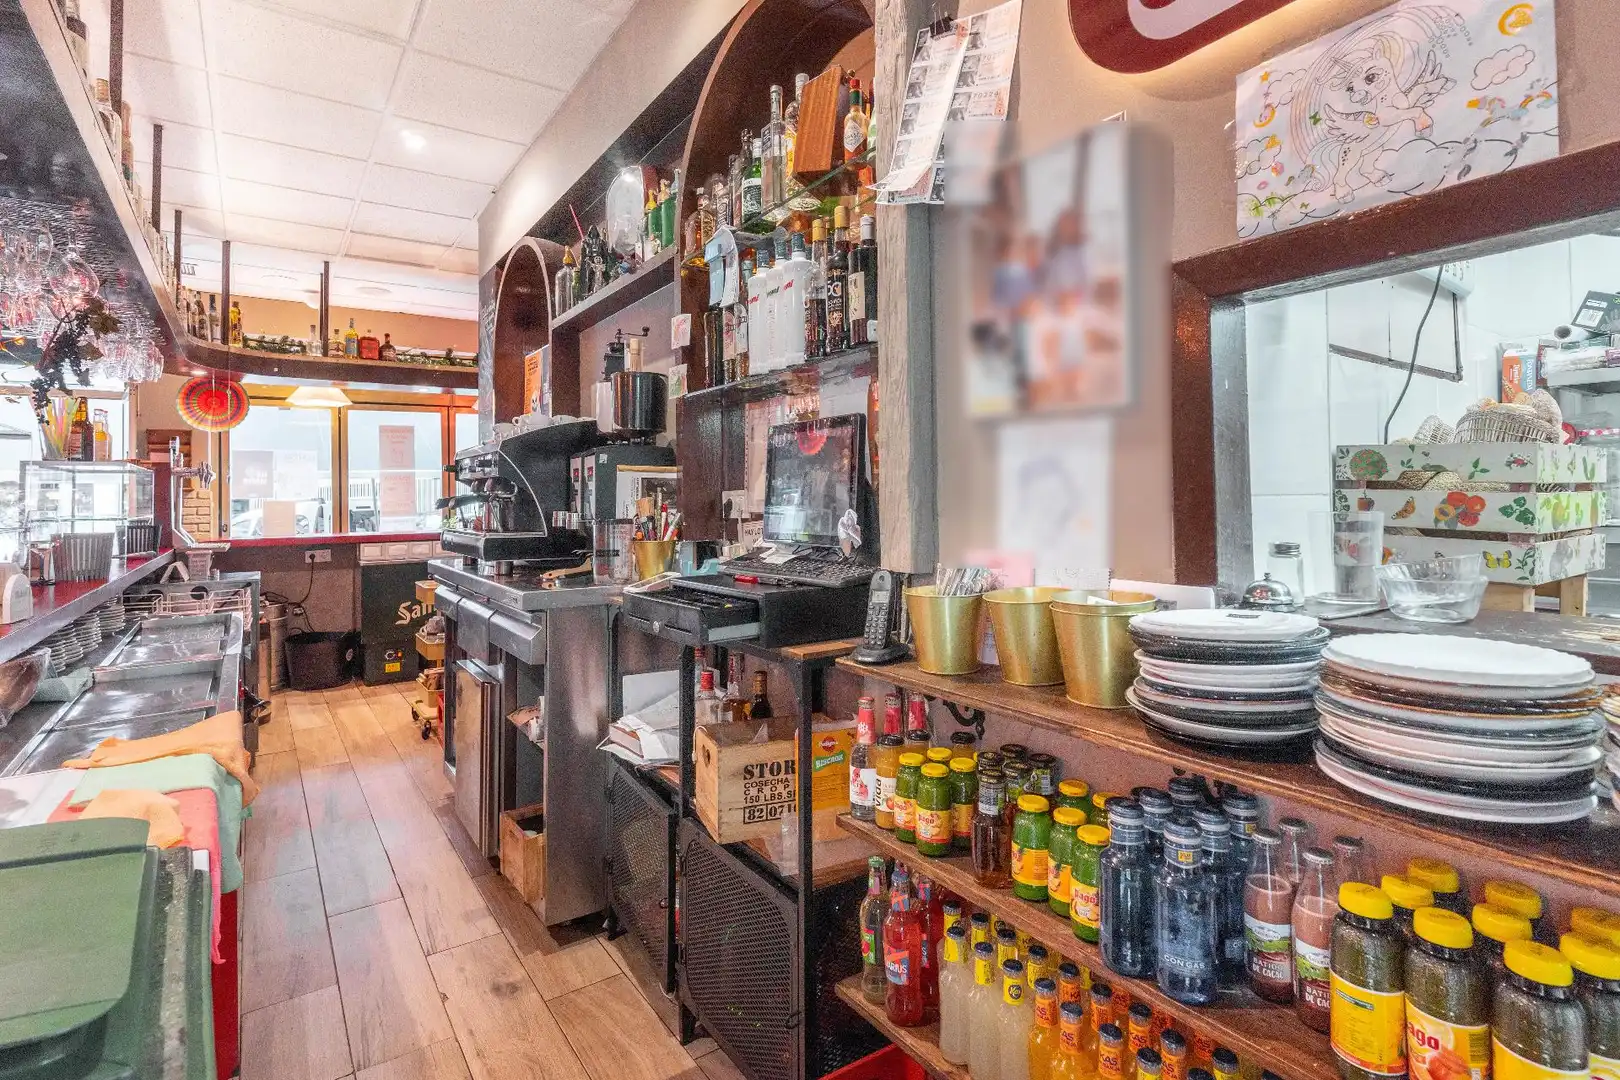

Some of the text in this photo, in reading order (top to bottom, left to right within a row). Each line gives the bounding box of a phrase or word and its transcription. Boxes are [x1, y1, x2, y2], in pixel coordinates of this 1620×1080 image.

[744, 777, 790, 789] COSECHA
[744, 795, 760, 804] 150
[747, 808, 764, 820] 82
[1164, 955, 1205, 970] CON GAS
[1407, 1021, 1439, 1051] ago
